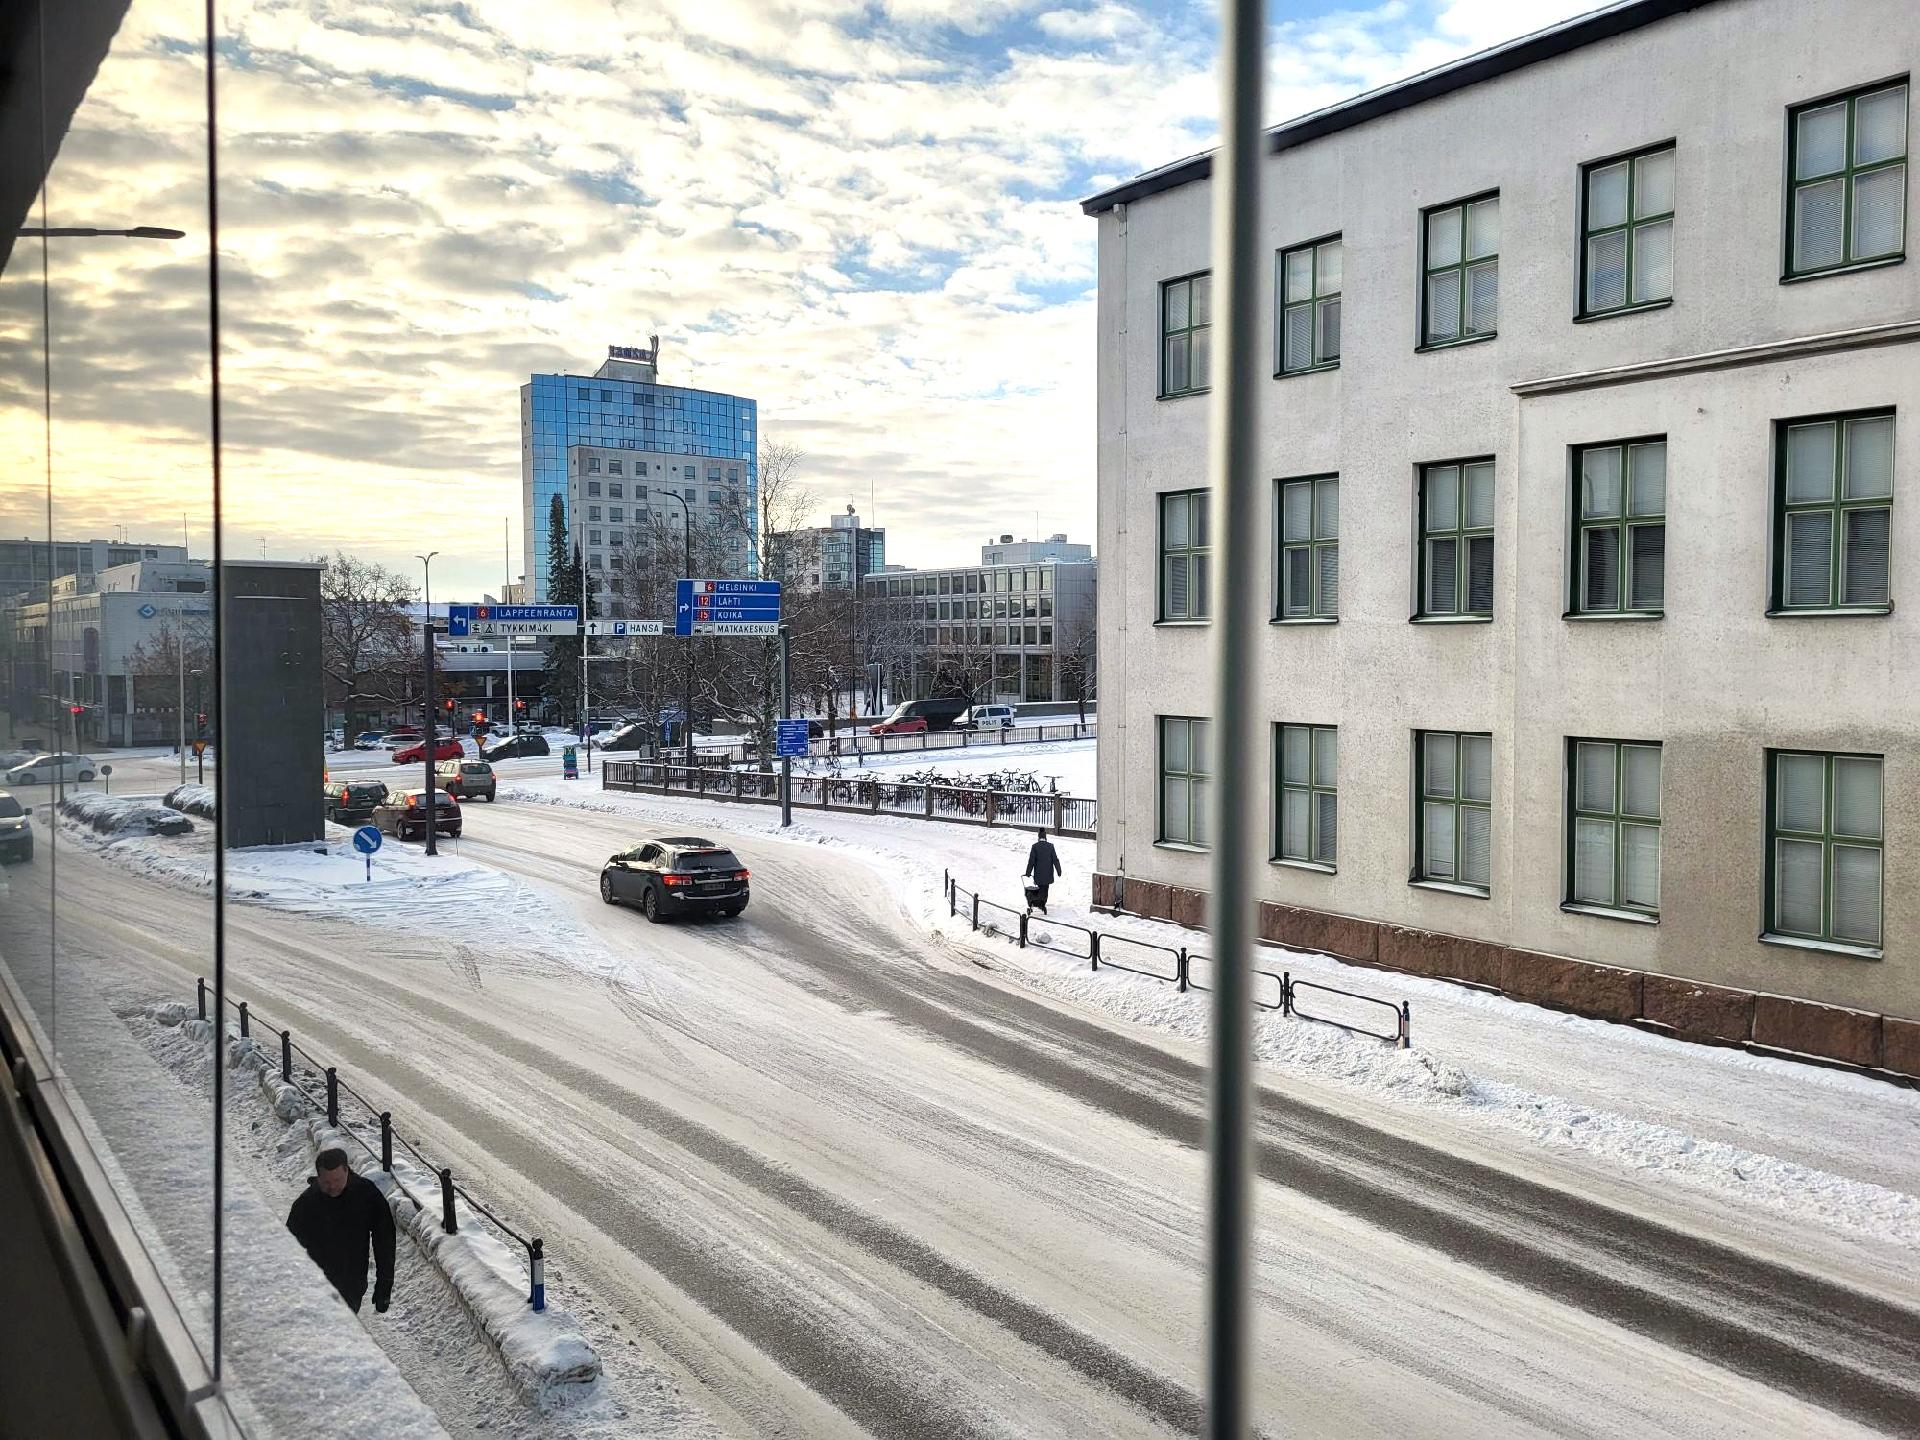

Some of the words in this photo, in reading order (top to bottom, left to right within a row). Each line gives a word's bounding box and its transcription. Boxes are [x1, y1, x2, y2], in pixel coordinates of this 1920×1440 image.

[706, 583, 713, 592] 6
[718, 583, 757, 592] HELSINKI
[700, 596, 709, 606] 12
[480, 608, 487, 617] 6
[500, 608, 574, 618] LAPPEENRANTA
[616, 624, 624, 634] P
[629, 624, 660, 634] HANSA
[716, 624, 776, 635] MATKAKESKUS
